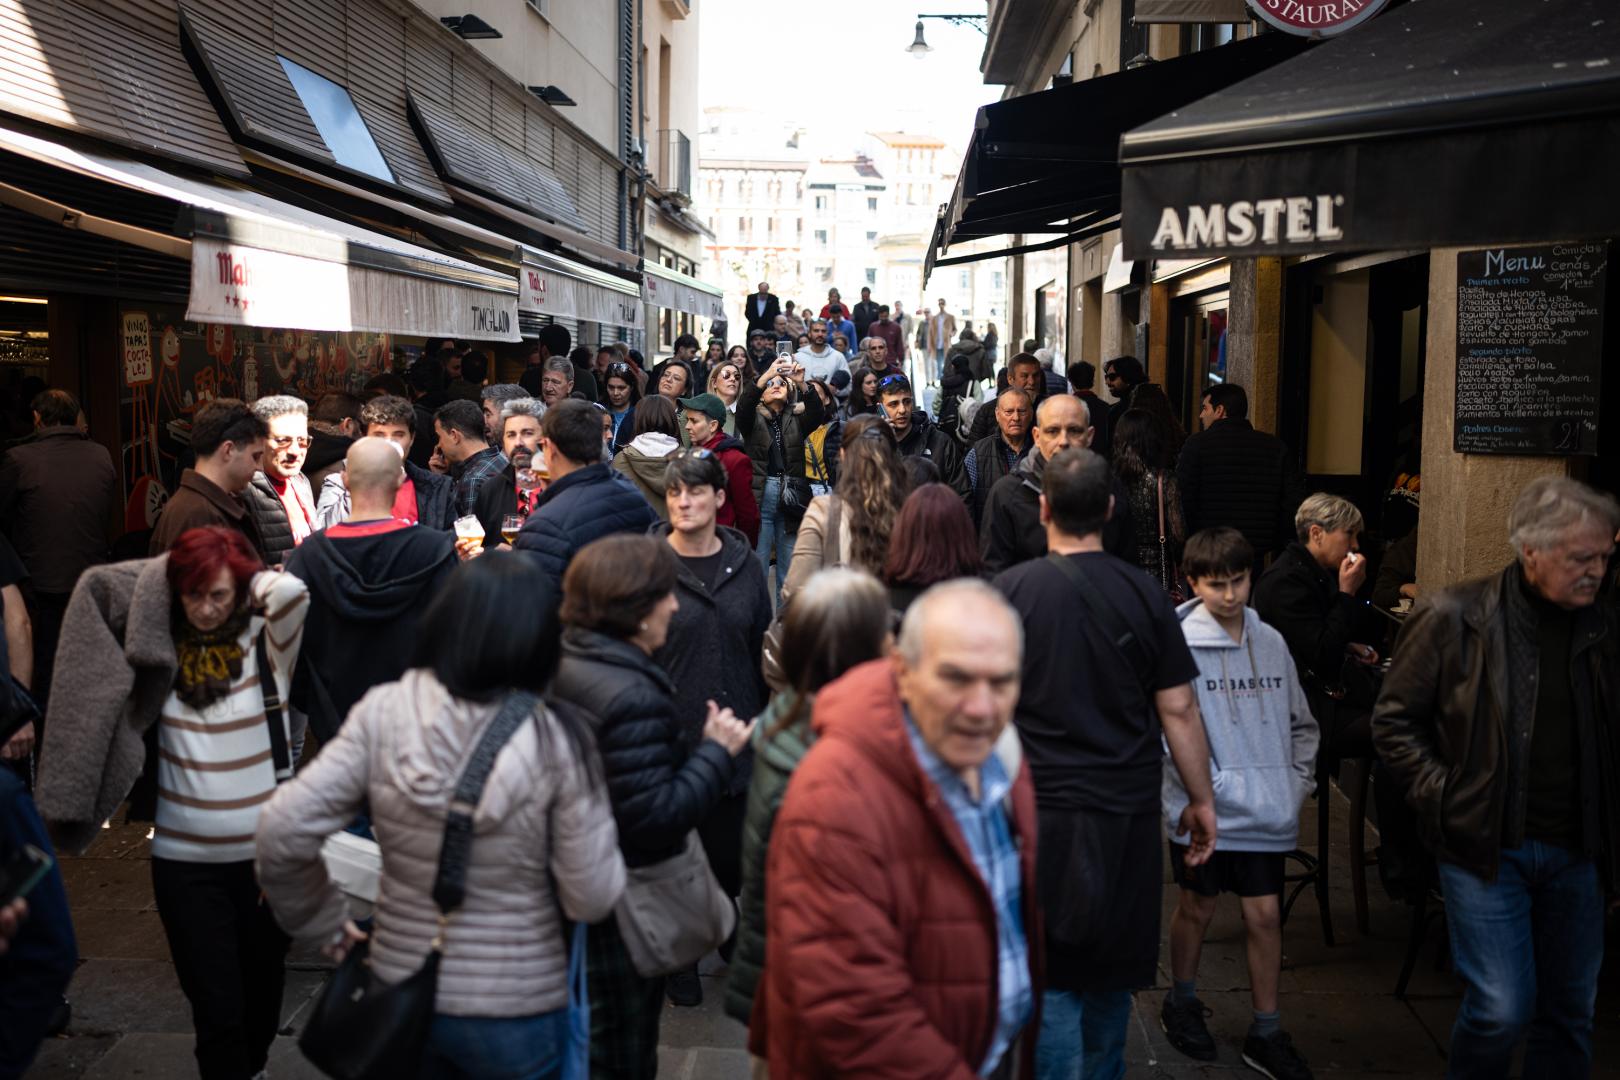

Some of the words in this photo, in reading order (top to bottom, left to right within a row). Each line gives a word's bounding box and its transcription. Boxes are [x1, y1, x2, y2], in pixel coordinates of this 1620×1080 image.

[1267, 0, 1363, 24] STAURA
[1151, 195, 1343, 250] AMSTEL
[1484, 250, 1546, 277] Menu
[1551, 261, 1590, 271] Cenas
[125, 335, 147, 346] TAPAS
